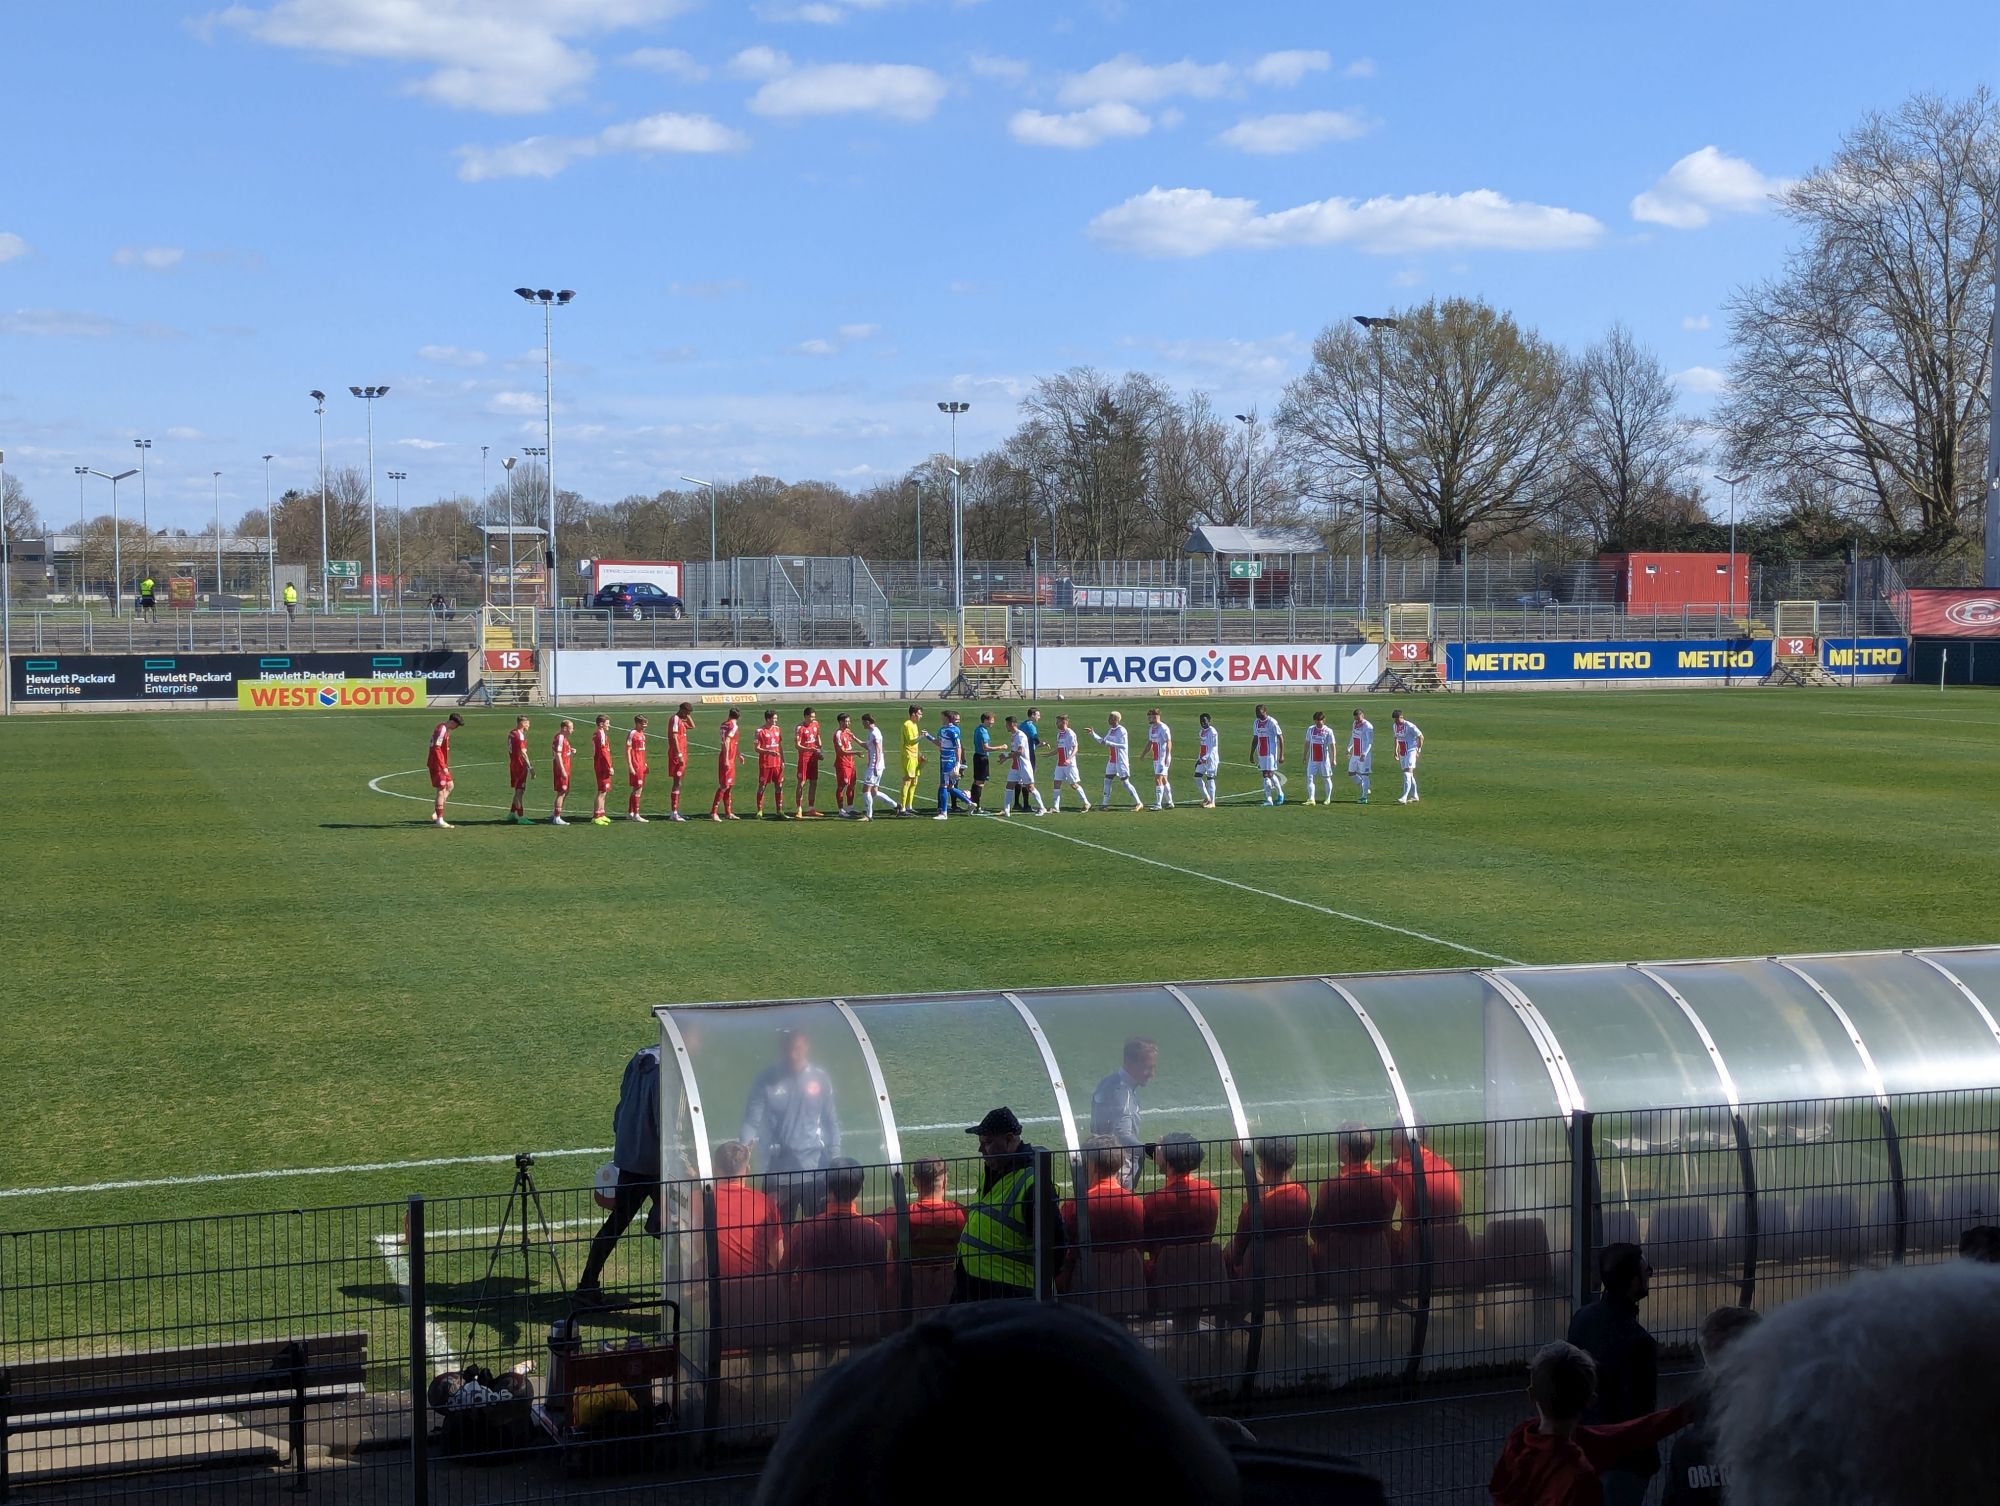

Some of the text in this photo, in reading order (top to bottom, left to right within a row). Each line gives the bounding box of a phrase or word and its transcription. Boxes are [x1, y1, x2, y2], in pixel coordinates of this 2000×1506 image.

[1401, 643, 1418, 659] 13
[1788, 639, 1804, 655] 12
[499, 652, 520, 669] 15
[976, 648, 994, 664] 14
[1466, 652, 1545, 671] METRO
[1573, 651, 1651, 670] METRO
[1678, 650, 1754, 668] METRO
[1829, 648, 1902, 667] METRO
[260, 670, 345, 680] Hewlett Packard
[372, 670, 455, 679] Hewlett Packard
[617, 658, 889, 689] TARGO BANK
[1080, 653, 1322, 683] TARGO BANK
[26, 673, 115, 684] Hewlett Packard
[145, 672, 232, 683] Hewlett Packard
[26, 685, 81, 696] Enterprise
[145, 683, 198, 695] Enterprise
[250, 686, 415, 707] WEST LOTTO
